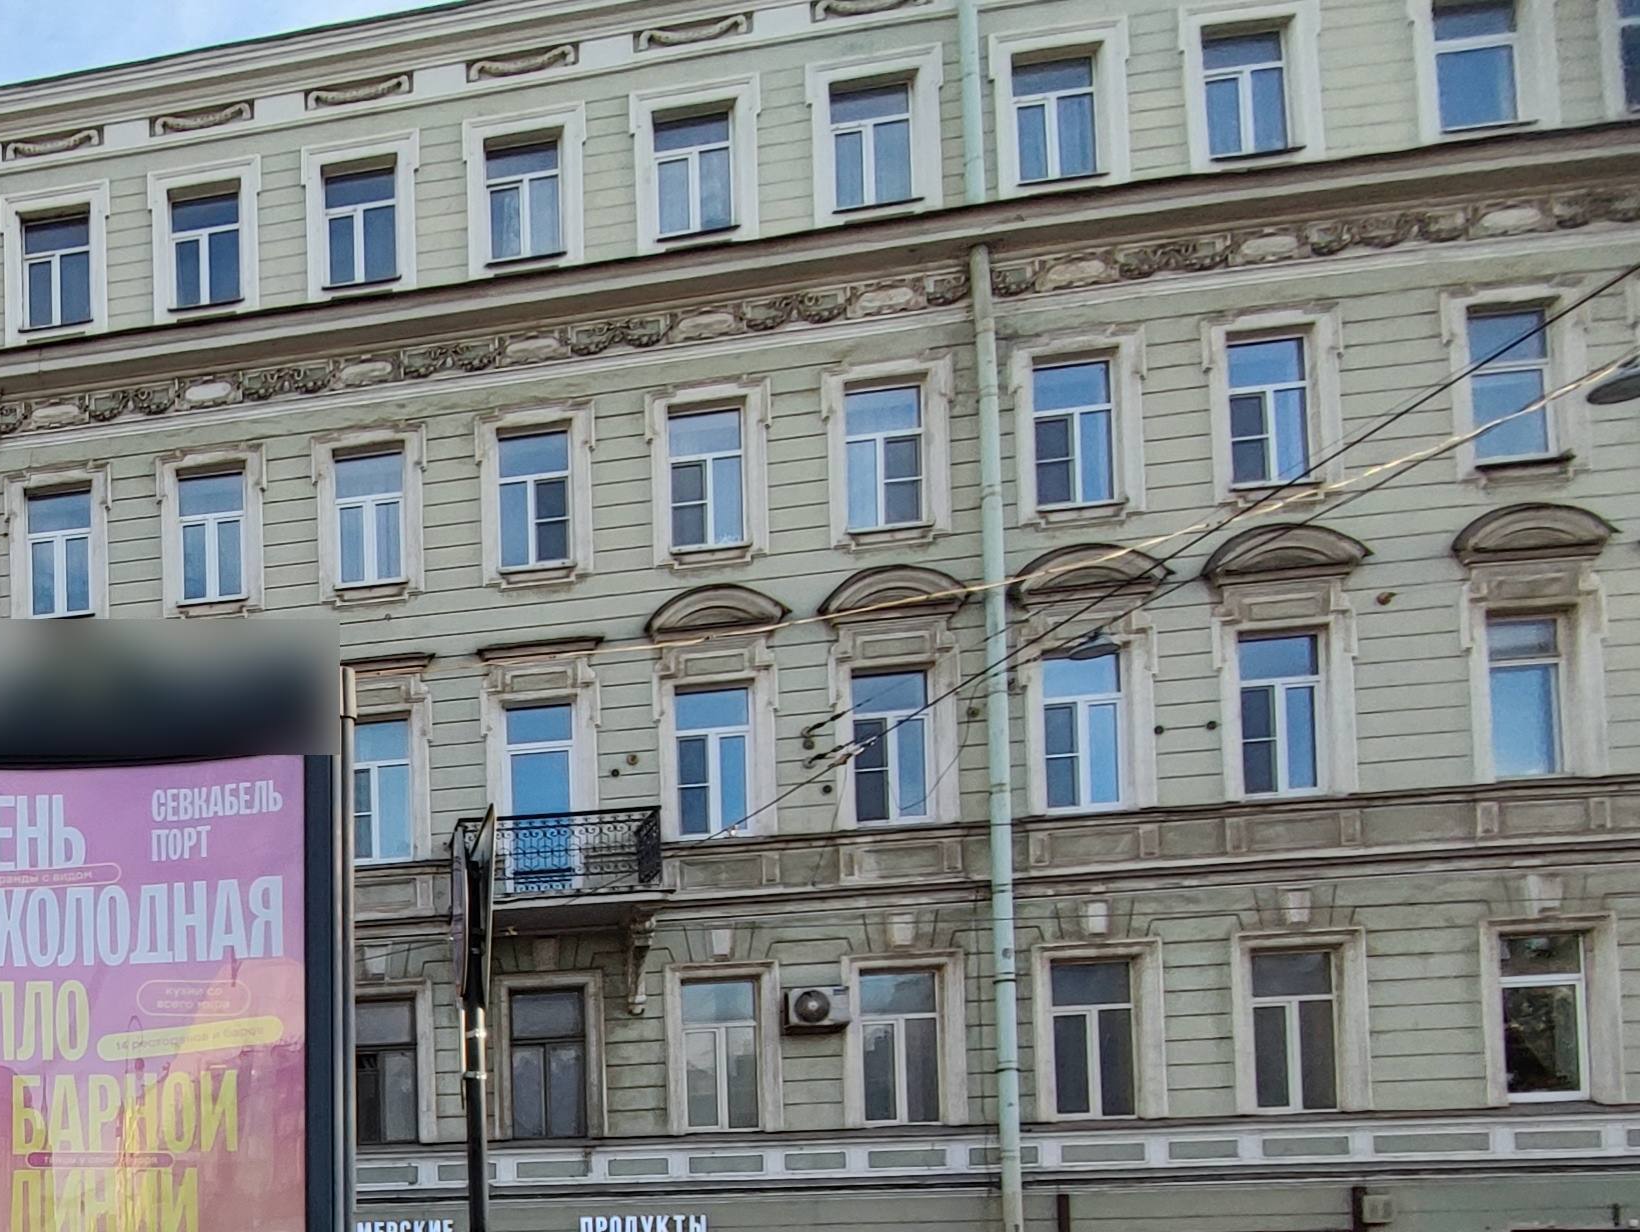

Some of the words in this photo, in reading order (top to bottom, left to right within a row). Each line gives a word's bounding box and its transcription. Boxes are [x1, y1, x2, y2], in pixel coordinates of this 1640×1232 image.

[152, 780, 283, 822] СЕВКАБЕЛЬ
[152, 825, 211, 861] ПОРТ
[13, 1064, 238, 1155] БАРНОЙ
